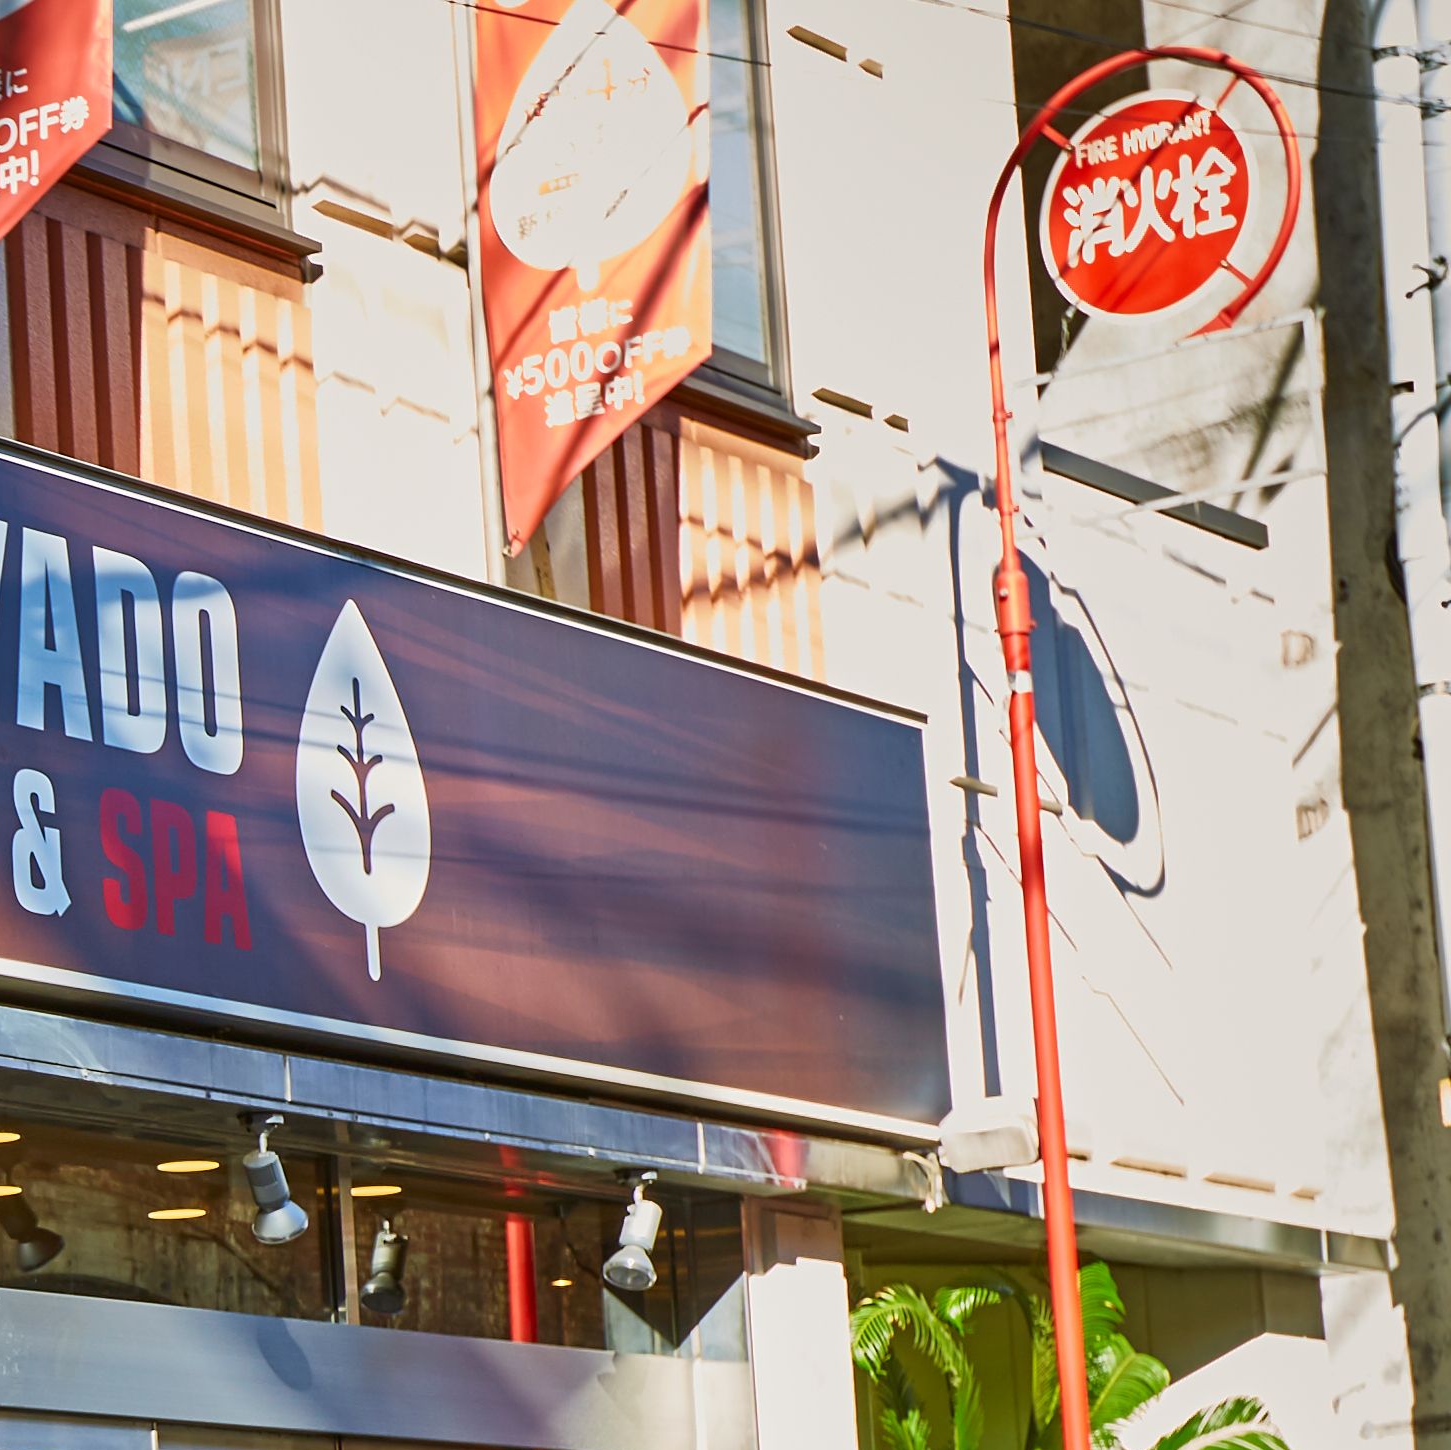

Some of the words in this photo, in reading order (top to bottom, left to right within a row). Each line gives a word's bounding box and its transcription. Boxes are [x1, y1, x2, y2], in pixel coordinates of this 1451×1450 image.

[1062, 146, 1237, 269] 消火栓
[1075, 135, 1118, 168] FIRE
[12, 768, 71, 917] &
[99, 788, 252, 952] SPA
